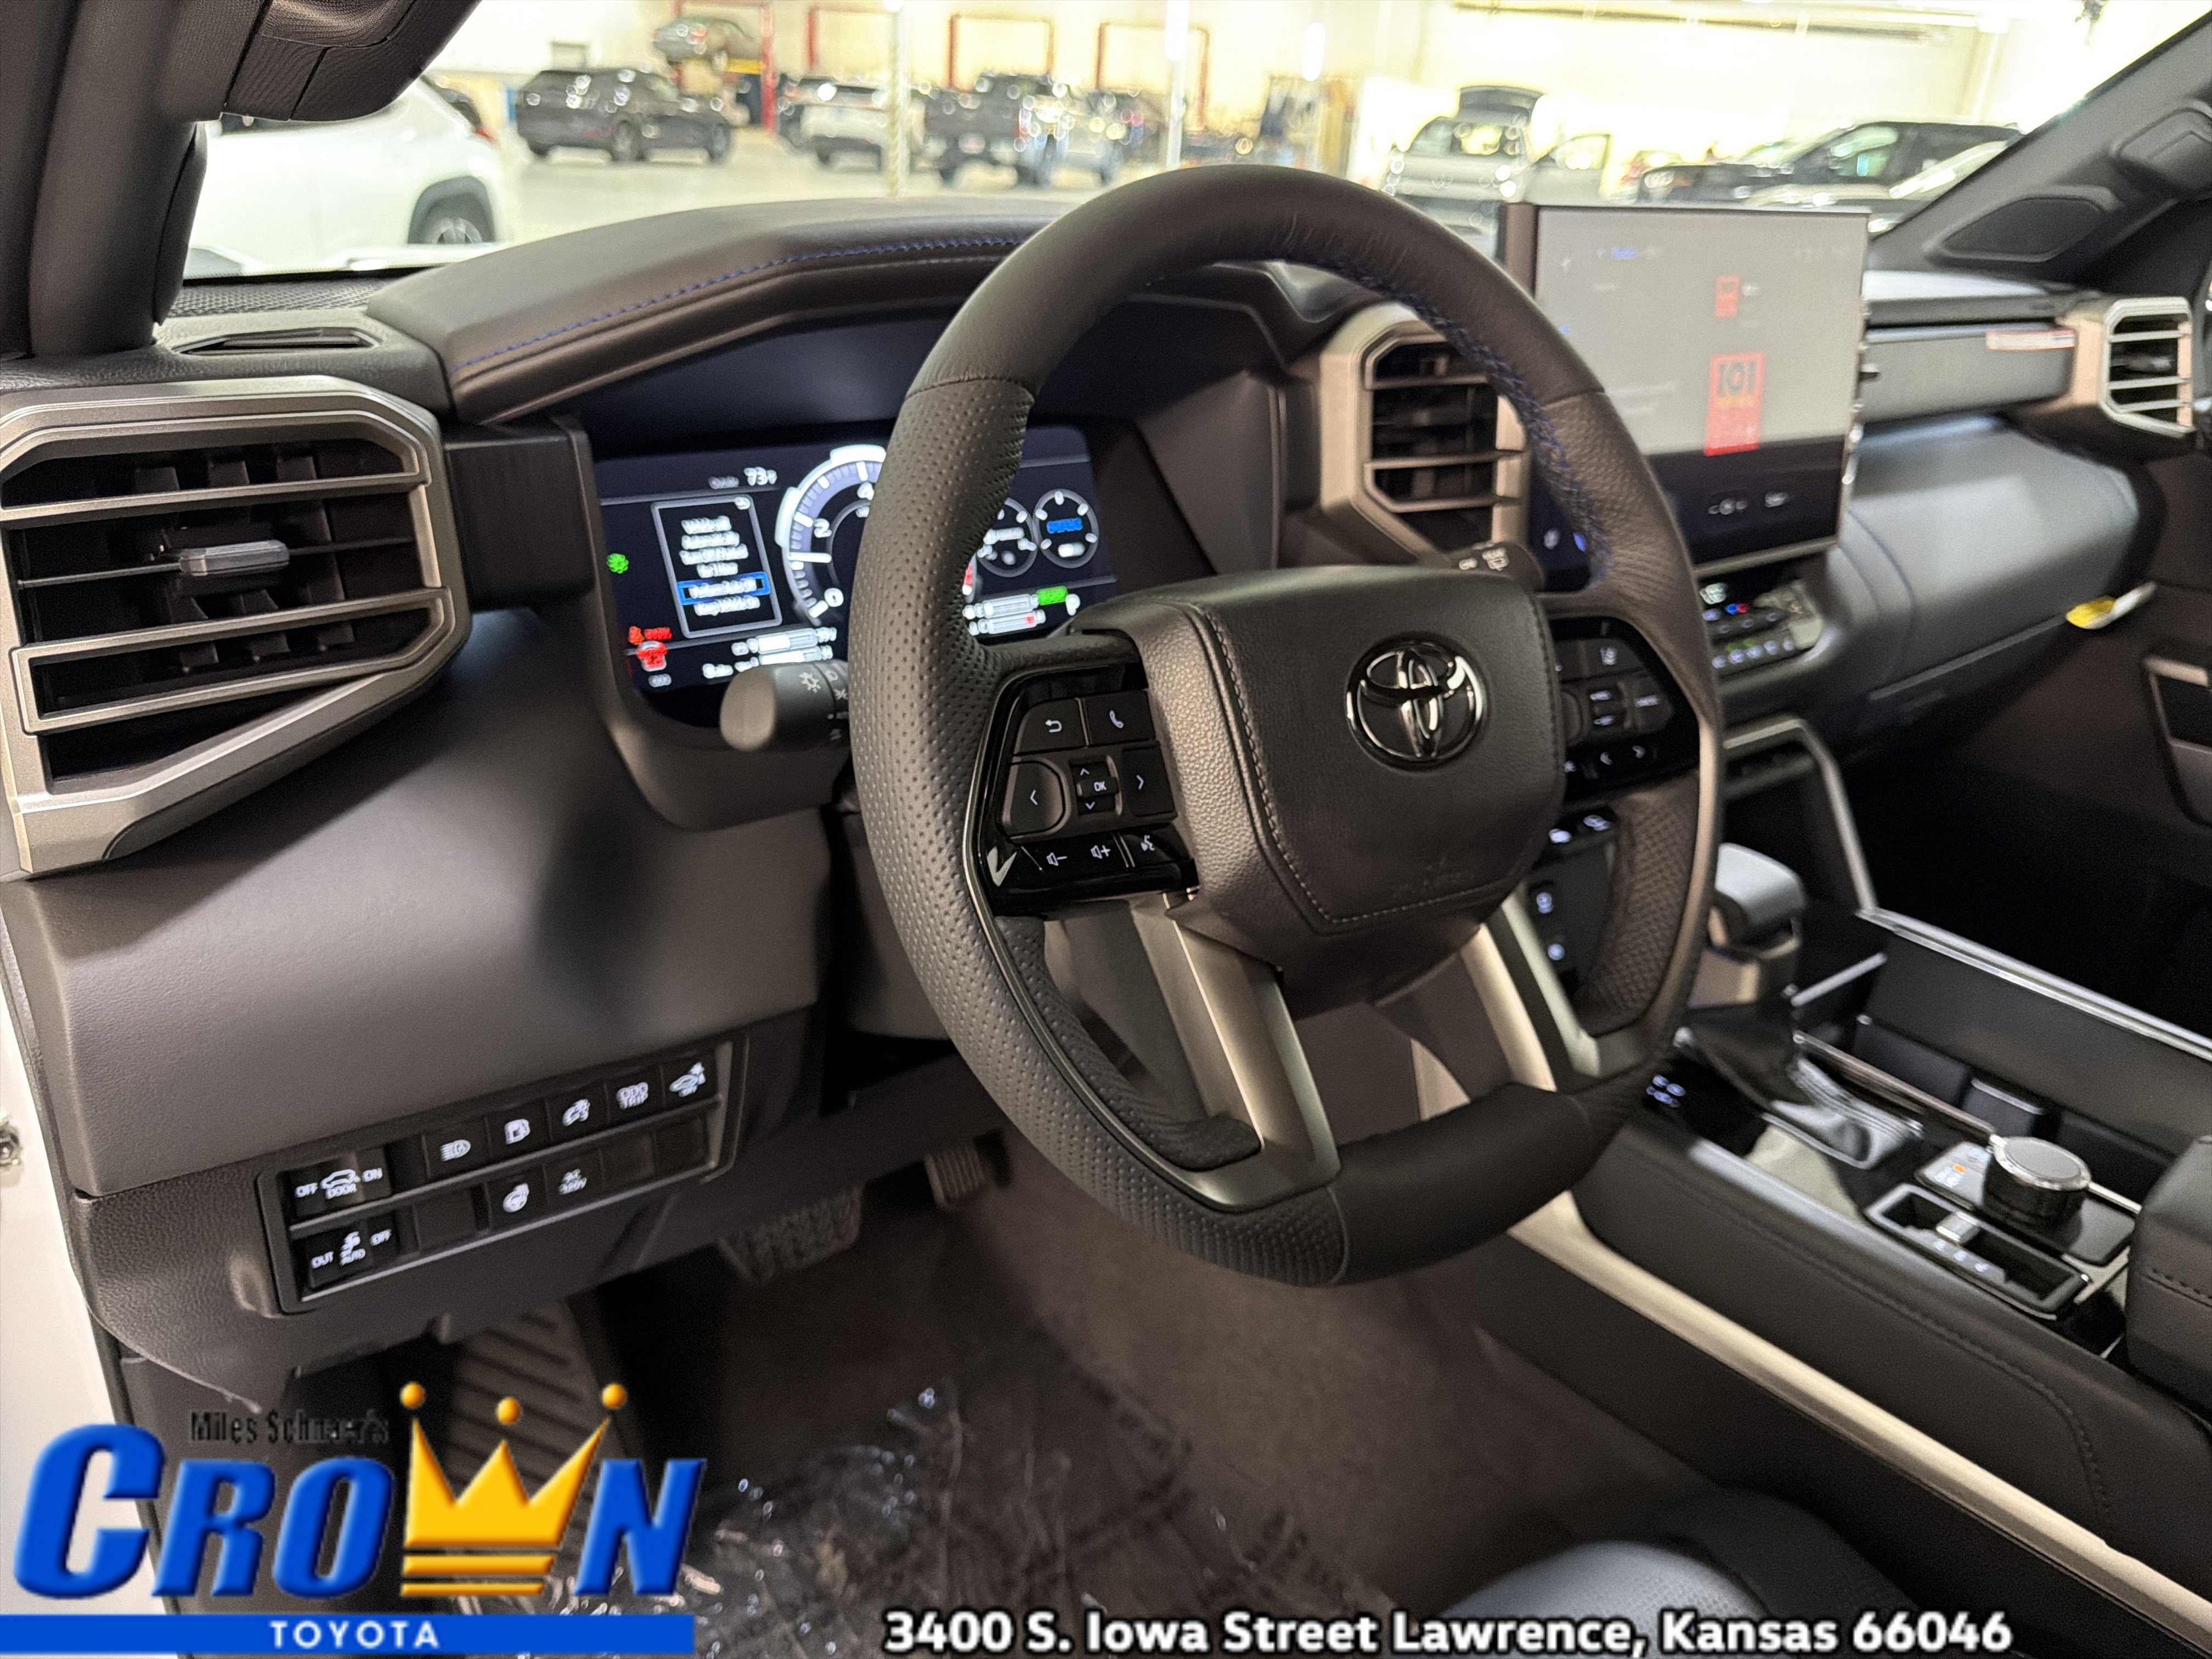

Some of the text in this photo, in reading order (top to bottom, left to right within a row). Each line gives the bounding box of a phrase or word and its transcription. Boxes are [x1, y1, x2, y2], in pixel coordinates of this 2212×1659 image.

[814, 518, 832, 538] 2
[824, 588, 844, 607] 0
[1094, 781, 1107, 792] OK
[363, 1167, 383, 1182] ON
[295, 1182, 318, 1198] OFF
[311, 1251, 334, 1269] OUT
